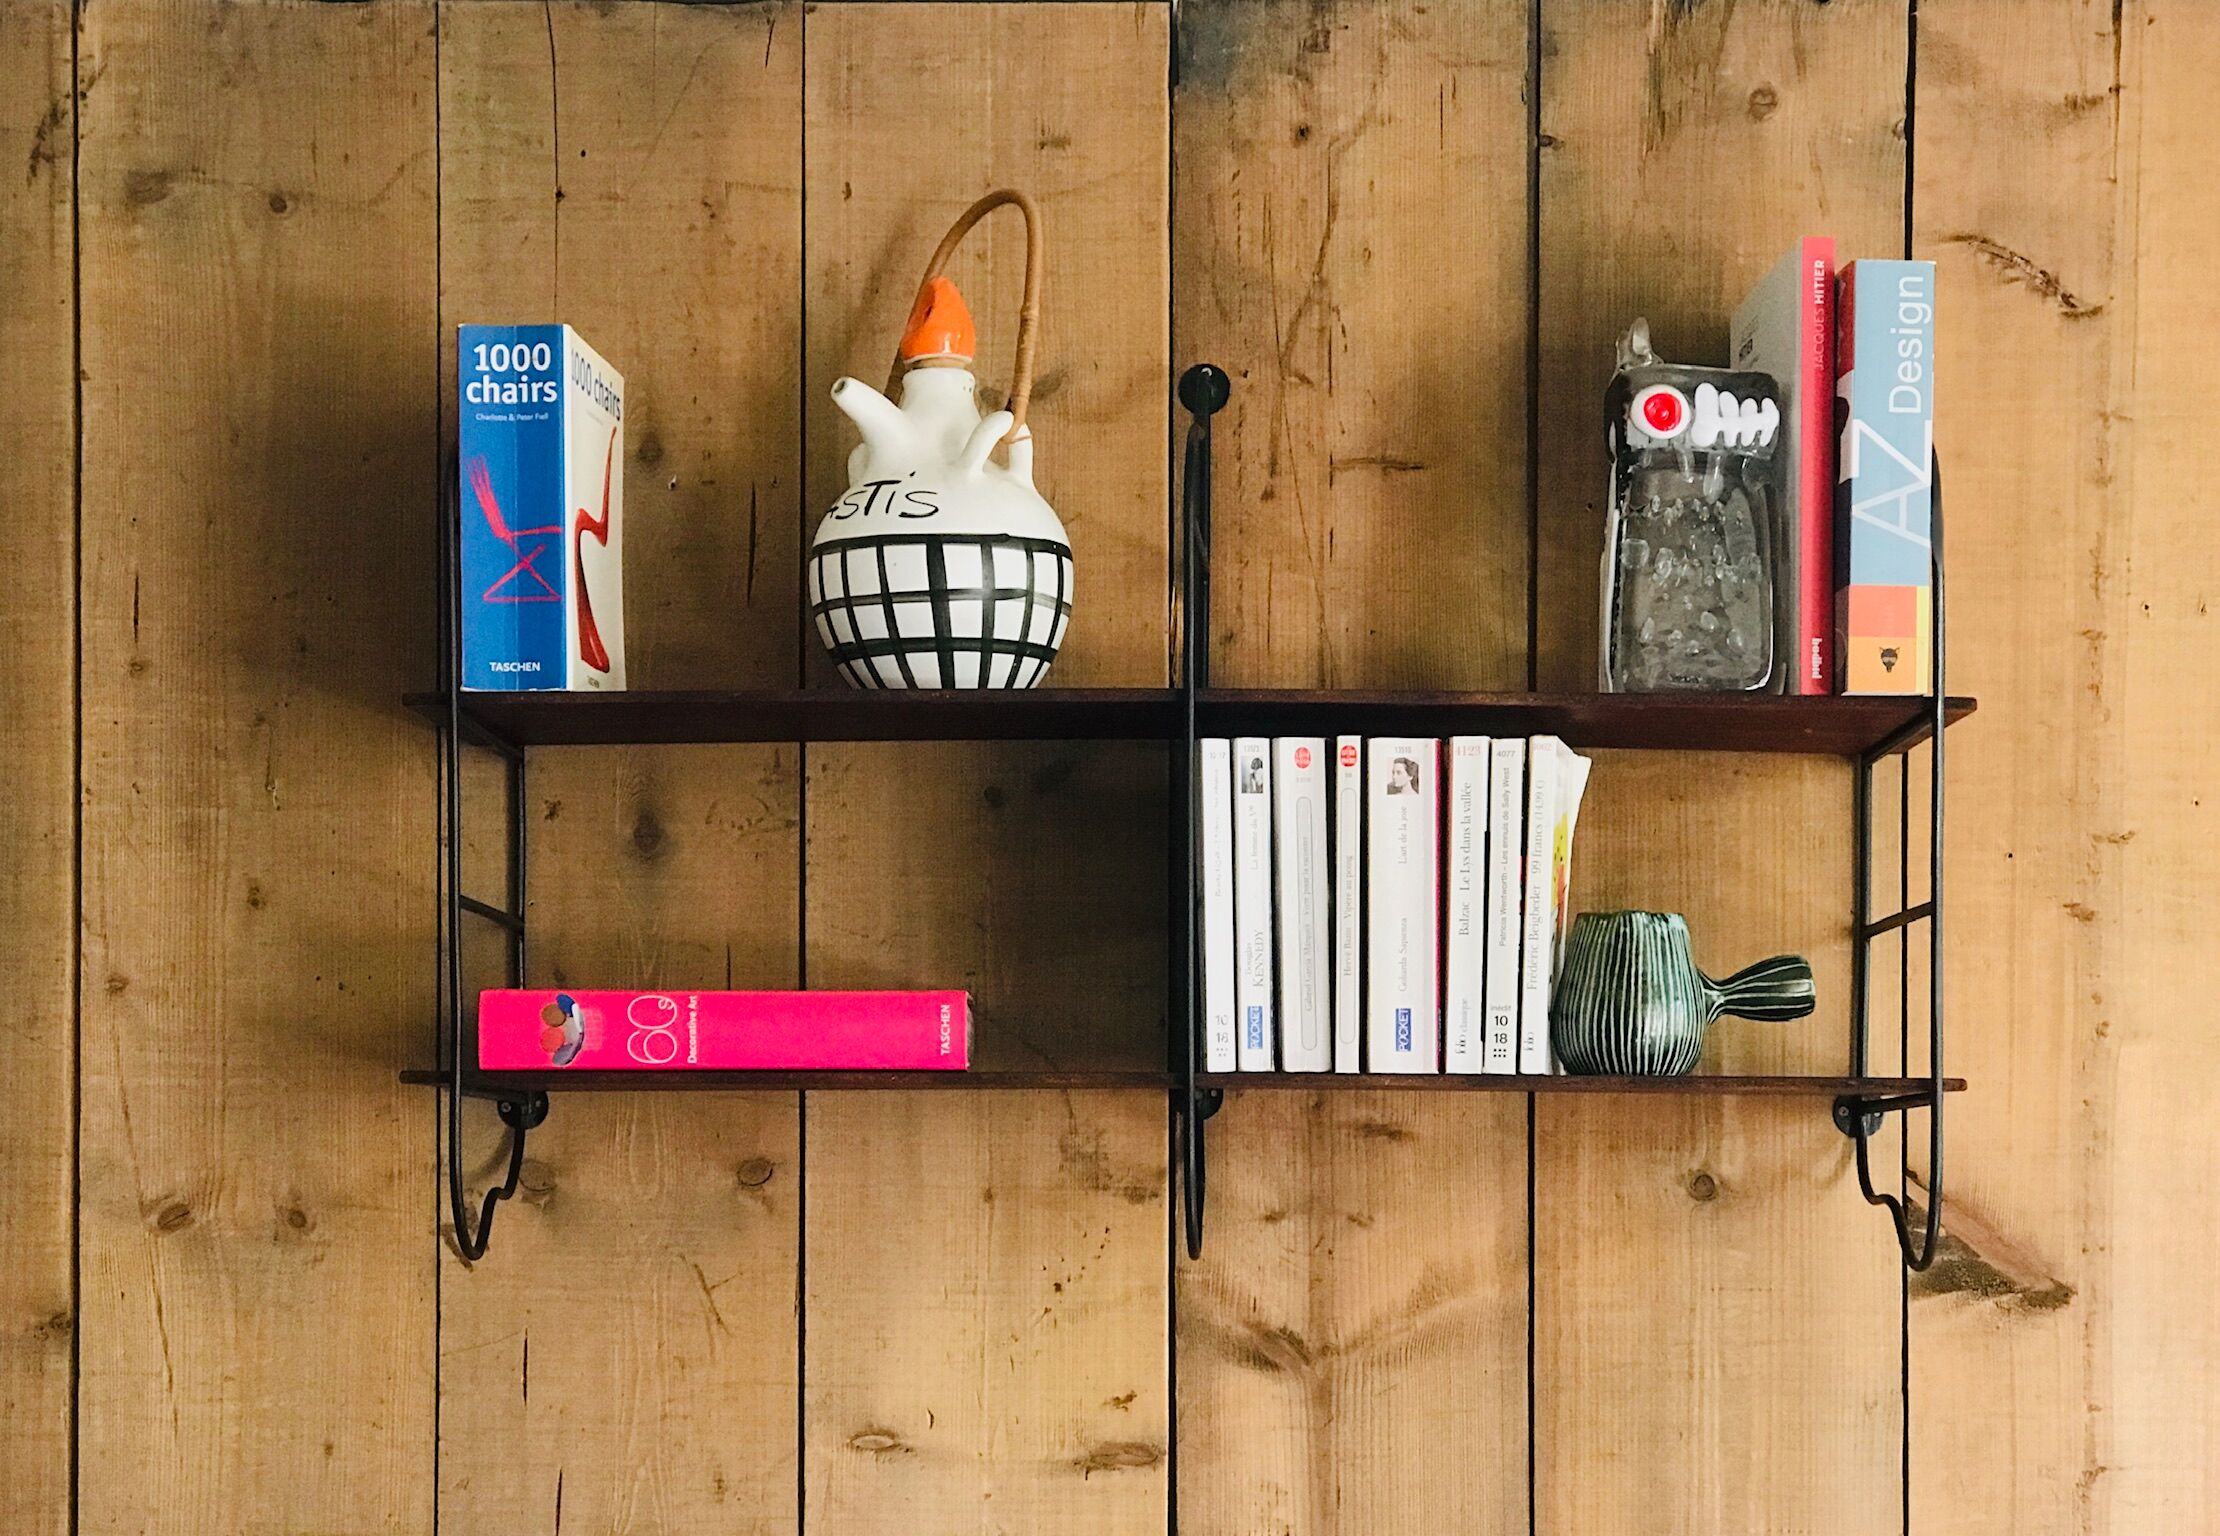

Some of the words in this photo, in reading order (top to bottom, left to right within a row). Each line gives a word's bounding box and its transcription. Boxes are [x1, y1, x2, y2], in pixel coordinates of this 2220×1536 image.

[1813, 260, 1825, 304] HITIER
[1813, 309, 1825, 371] JACQUES
[1888, 276, 1932, 414] Design
[473, 343, 551, 372] 1000
[466, 375, 558, 404] chairs
[571, 348, 592, 397] 1000
[594, 371, 620, 422] chairs
[508, 412, 515, 422] &
[516, 413, 533, 421] Peter
[489, 662, 541, 672] TASCHEN
[1496, 750, 1516, 758] 4077
[1502, 768, 1510, 787] West
[1460, 782, 1473, 813] vallée
[1501, 790, 1511, 808] Sally
[1398, 823, 1408, 831] la
[1460, 815, 1472, 824] la
[1500, 811, 1509, 821] de
[1398, 833, 1408, 843] de
[1460, 827, 1471, 853] dans
[1500, 823, 1509, 849] ennuis
[1532, 824, 1544, 857] francs
[1459, 855, 1474, 873] Lys
[1501, 850, 1509, 864] Les
[1530, 860, 1542, 874] 99
[1459, 877, 1471, 890] Le
[1499, 873, 1508, 915] Wentworth
[1459, 902, 1470, 935] Balzac
[1528, 886, 1543, 941] Beigbeder
[1397, 918, 1409, 954] Sapienza
[1499, 917, 1508, 946] Patricia
[1252, 929, 1265, 987] KENNEDY
[1526, 945, 1539, 990] Frédéric
[1397, 957, 1408, 992] Goliarda
[686, 995, 698, 1009] Art
[940, 1004, 950, 1056] TASCHEN
[1249, 1007, 1260, 1049] POCKET
[1397, 1009, 1408, 1052] POCKET
[1494, 1015, 1508, 1026] 10
[686, 1010, 698, 1064] Decorative
[1216, 1032, 1229, 1043] 18
[1494, 1033, 1508, 1044] 18
